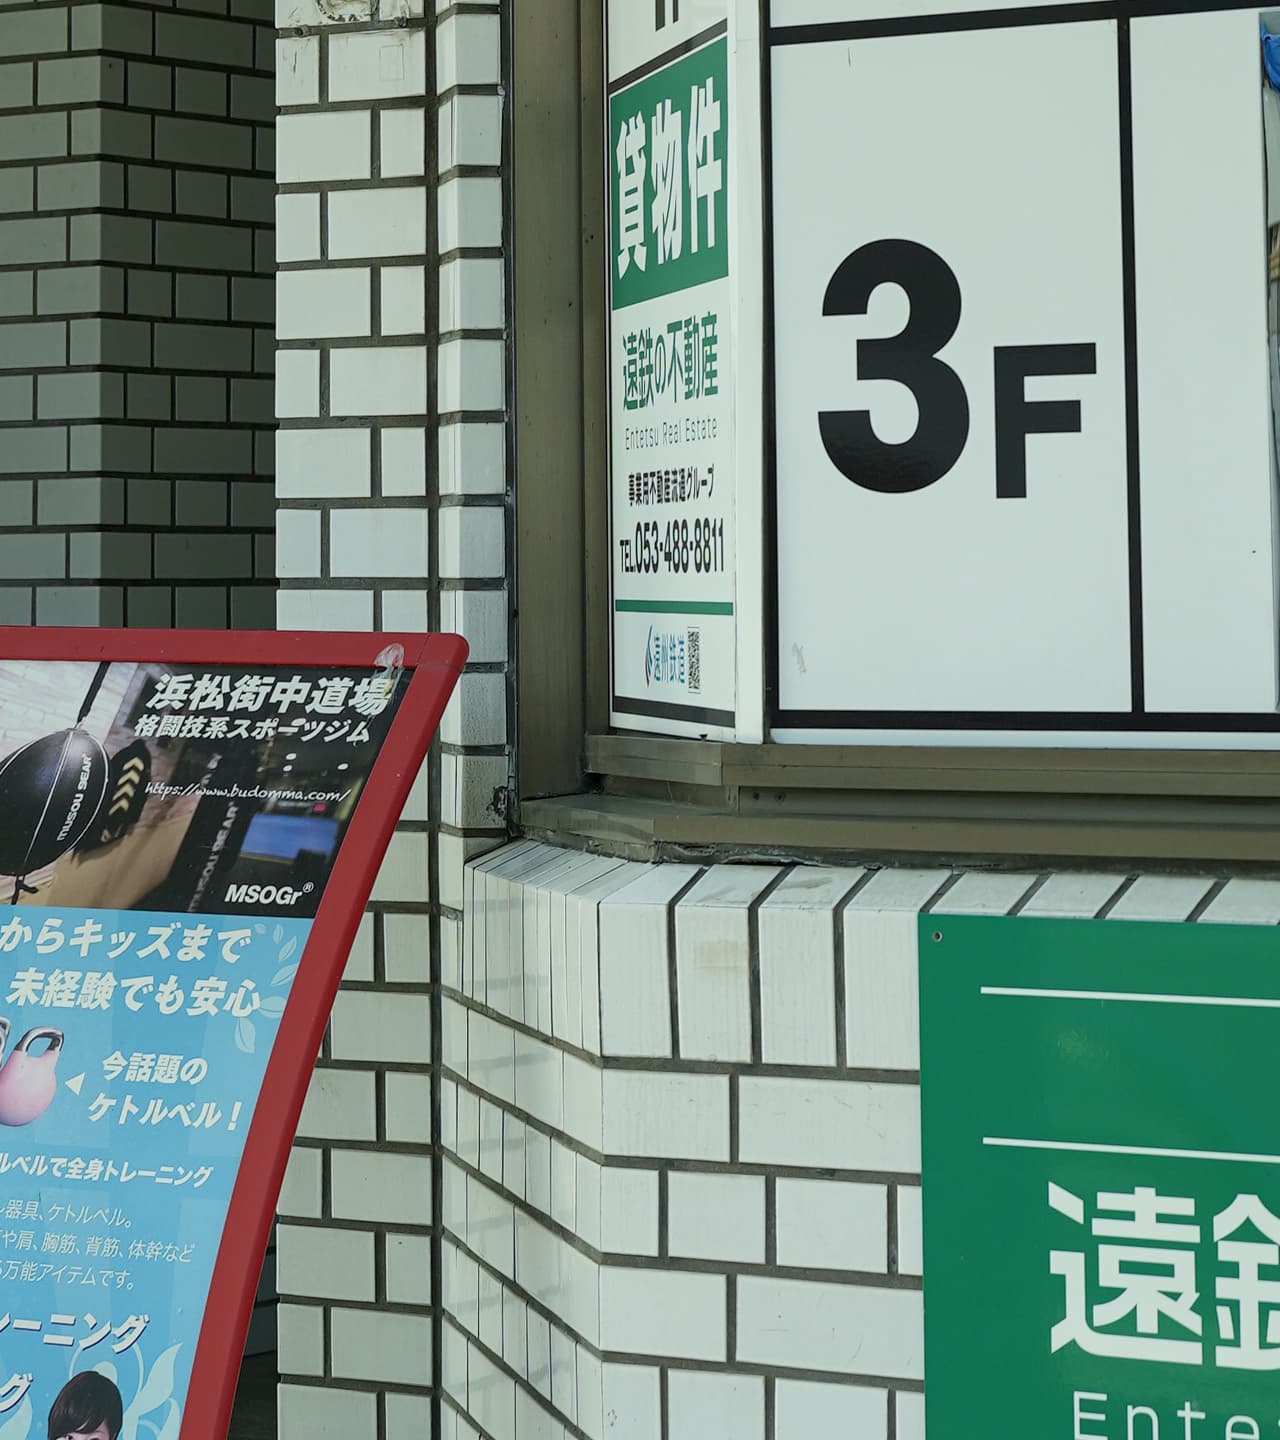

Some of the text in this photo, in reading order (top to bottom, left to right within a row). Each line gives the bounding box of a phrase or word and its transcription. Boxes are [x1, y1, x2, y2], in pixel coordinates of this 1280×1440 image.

[616, 76, 722, 281] 貸物件
[622, 311, 718, 412] 遠鉄の不動産
[818, 238, 1098, 500] 3F
[625, 416, 718, 451] Entetsu Real Estate
[146, 672, 393, 717] 浜松街中道場
[134, 714, 370, 744] 格闘技系スポーツジム
[144, 781, 351, 803] https://www.budomma.com/
[102, 1050, 208, 1086] 今話題の
[88, 1093, 242, 1132] ケトルベル！
